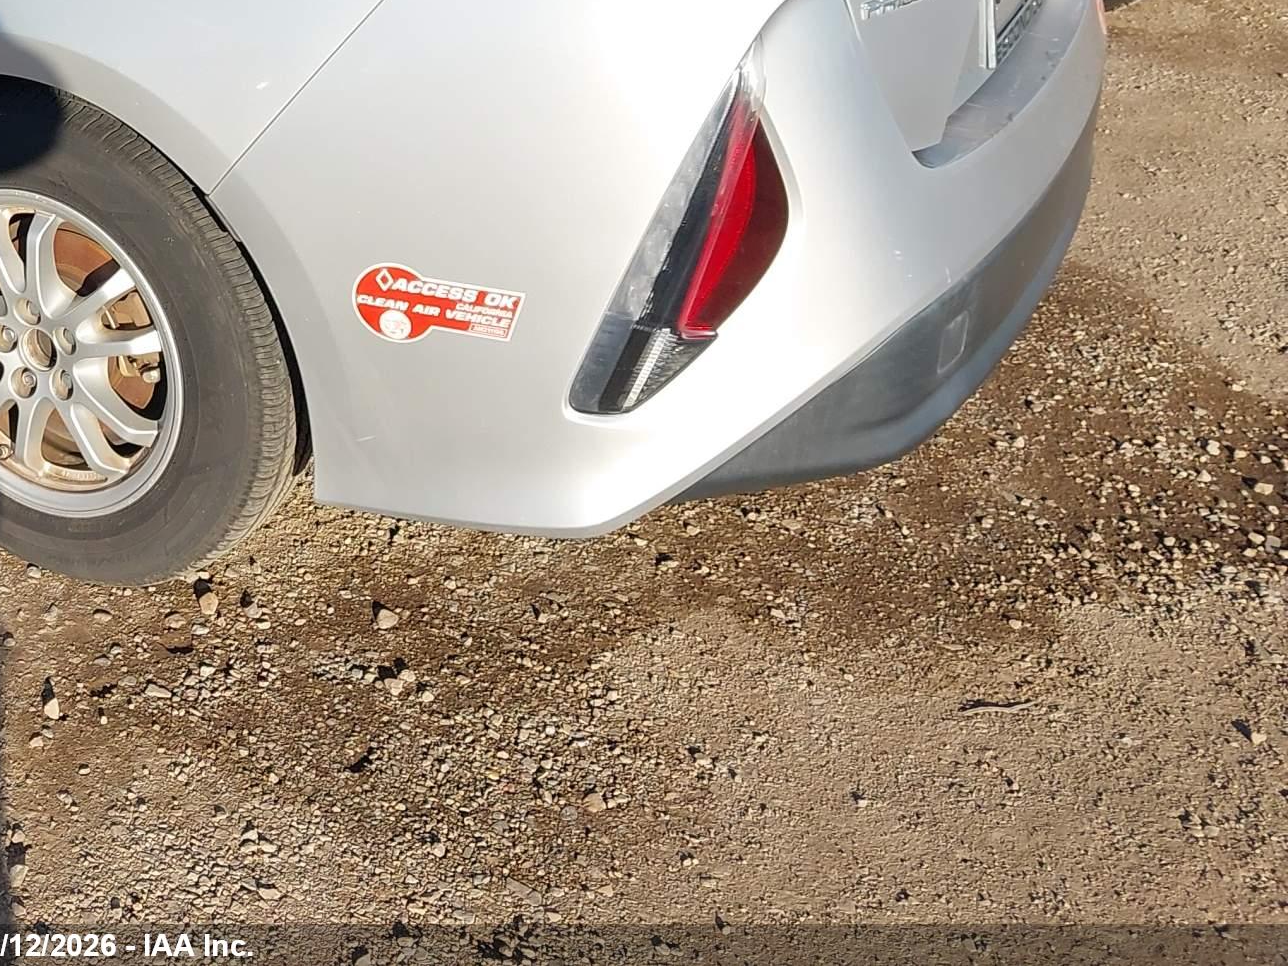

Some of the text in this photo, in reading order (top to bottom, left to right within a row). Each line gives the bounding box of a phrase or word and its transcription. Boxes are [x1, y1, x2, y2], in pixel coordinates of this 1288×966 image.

[391, 277, 516, 309] ACCESS OK
[357, 294, 513, 328] CLEAN AIR VEHICLE
